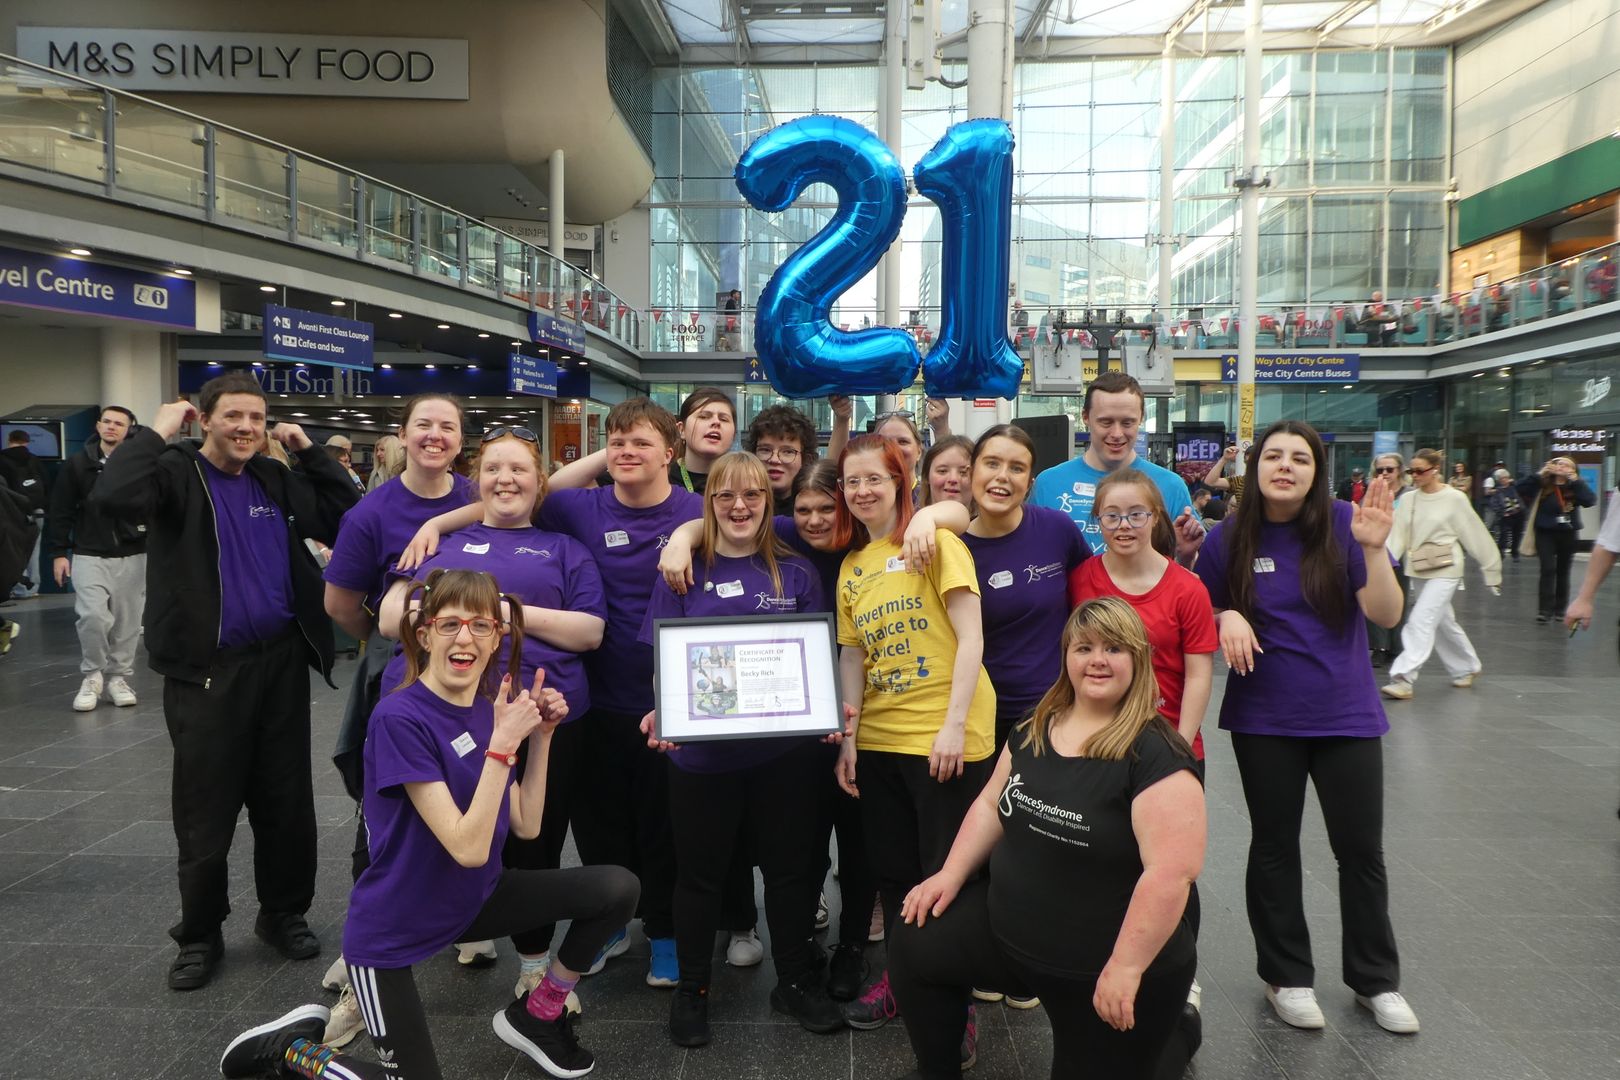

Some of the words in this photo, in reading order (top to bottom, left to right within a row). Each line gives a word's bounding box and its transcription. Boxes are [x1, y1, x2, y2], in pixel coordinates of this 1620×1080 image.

[48, 40, 136, 75] M&S
[152, 43, 302, 79] SIMPLY
[316, 48, 435, 83] FOOD
[517, 227, 549, 239] SIMPL
[563, 231, 588, 241] OOD
[734, 113, 1025, 400] 21
[36, 268, 114, 301] Centre
[298, 321, 318, 332] Avanti
[319, 325, 332, 335] First
[333, 327, 348, 338] Class
[348, 330, 370, 342] Lounge
[671, 324, 706, 334] FOOD
[317, 343, 330, 352] and
[330, 344, 345, 354] bars
[1255, 357, 1274, 367] Way
[1275, 357, 1291, 365] Out
[1298, 357, 1315, 367] City
[1316, 356, 1345, 365] Centre
[251, 368, 376, 394] HSmih
[1254, 369, 1273, 378] Free
[1274, 369, 1293, 380] City
[1294, 369, 1324, 378] Centre
[1325, 369, 1352, 378] Buses
[1178, 442, 1220, 460] DEEP
[886, 595, 923, 614] miss
[909, 617, 928, 631] to
[1011, 788, 1083, 822] DanceSyndrome
[1065, 820, 1091, 832] Inspired
